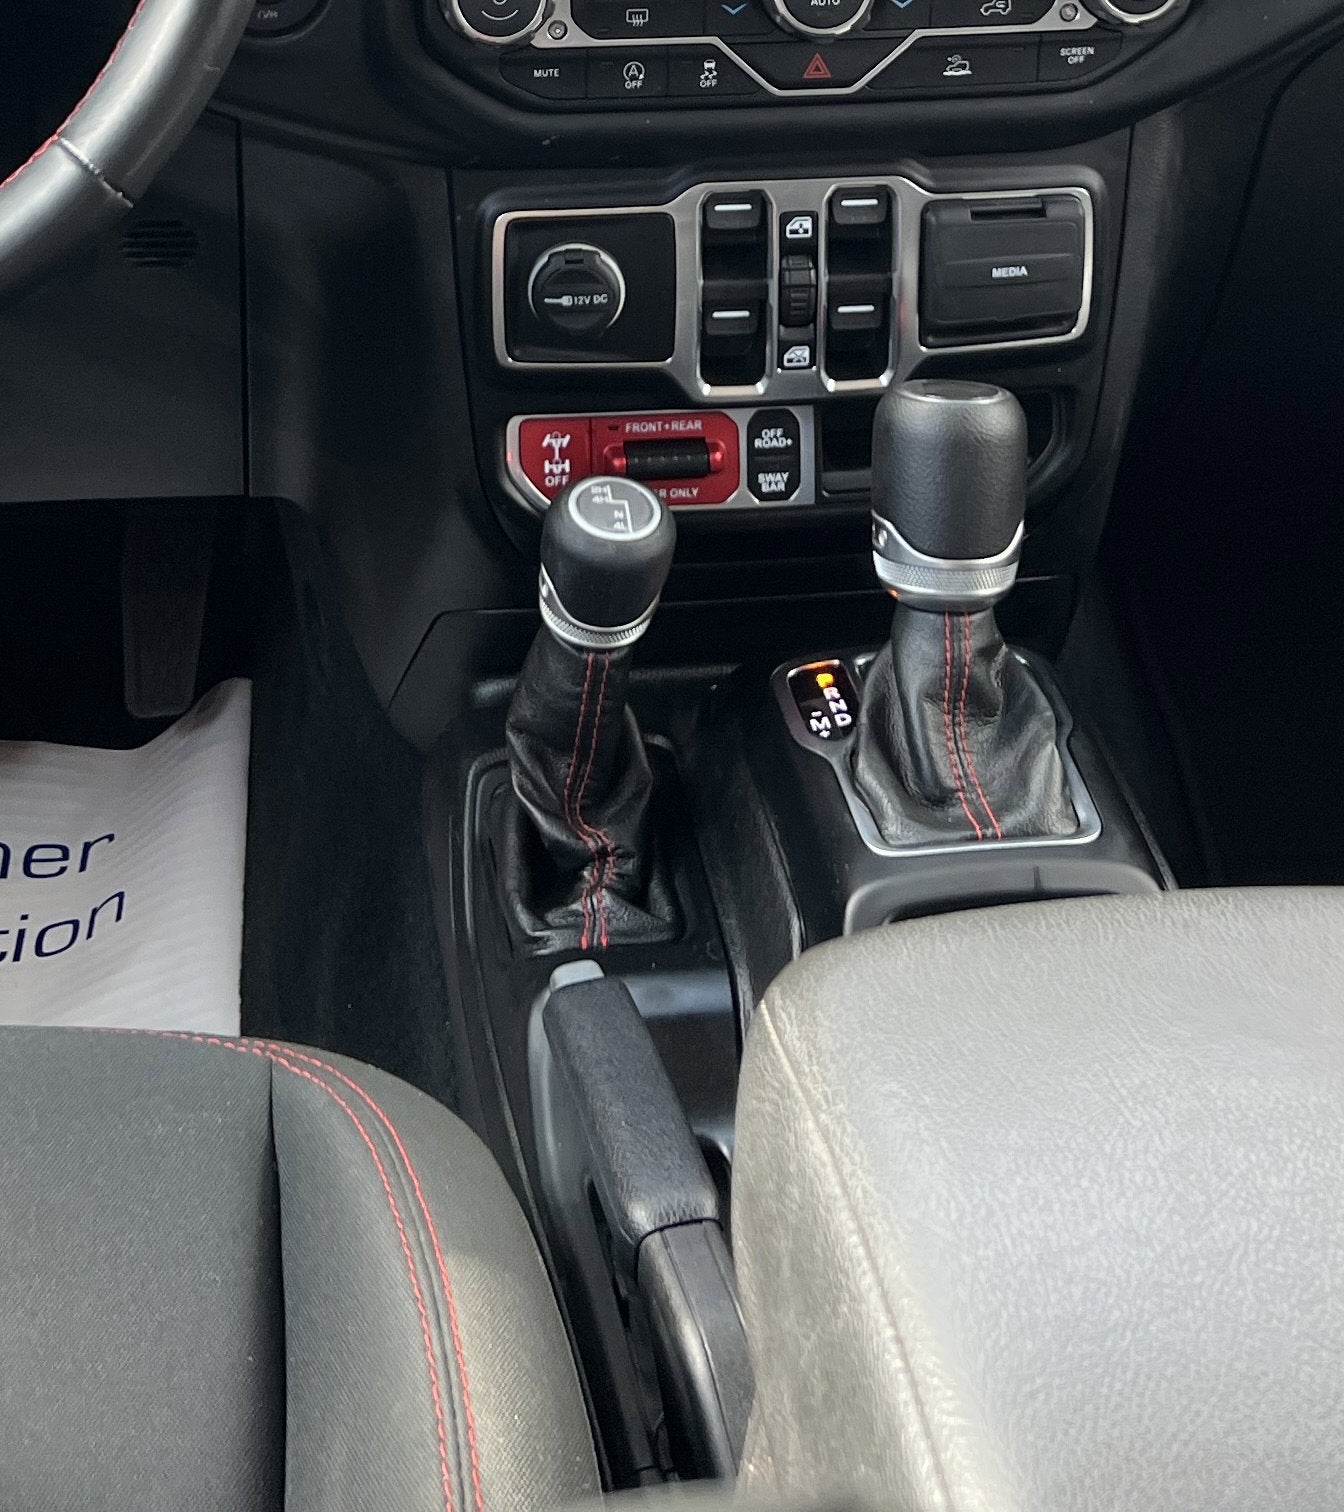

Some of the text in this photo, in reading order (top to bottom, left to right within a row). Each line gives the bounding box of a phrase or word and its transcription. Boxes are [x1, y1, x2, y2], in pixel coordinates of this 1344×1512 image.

[1060, 46, 1094, 56] SCREEN
[1067, 55, 1084, 64] OFF
[533, 68, 560, 78] MUTE
[624, 80, 644, 89] OFF
[700, 78, 718, 88] OFF
[992, 266, 1028, 278] MEDIA
[574, 294, 608, 305] 12V DC
[762, 428, 784, 439] OFF
[544, 476, 570, 488] OFF
[758, 472, 790, 484] SWAY
[670, 488, 700, 498] ONLY
[761, 482, 786, 493] BAR
[822, 686, 841, 700] R
[828, 698, 848, 714] N
[809, 716, 832, 732] M
[834, 713, 852, 728] D
